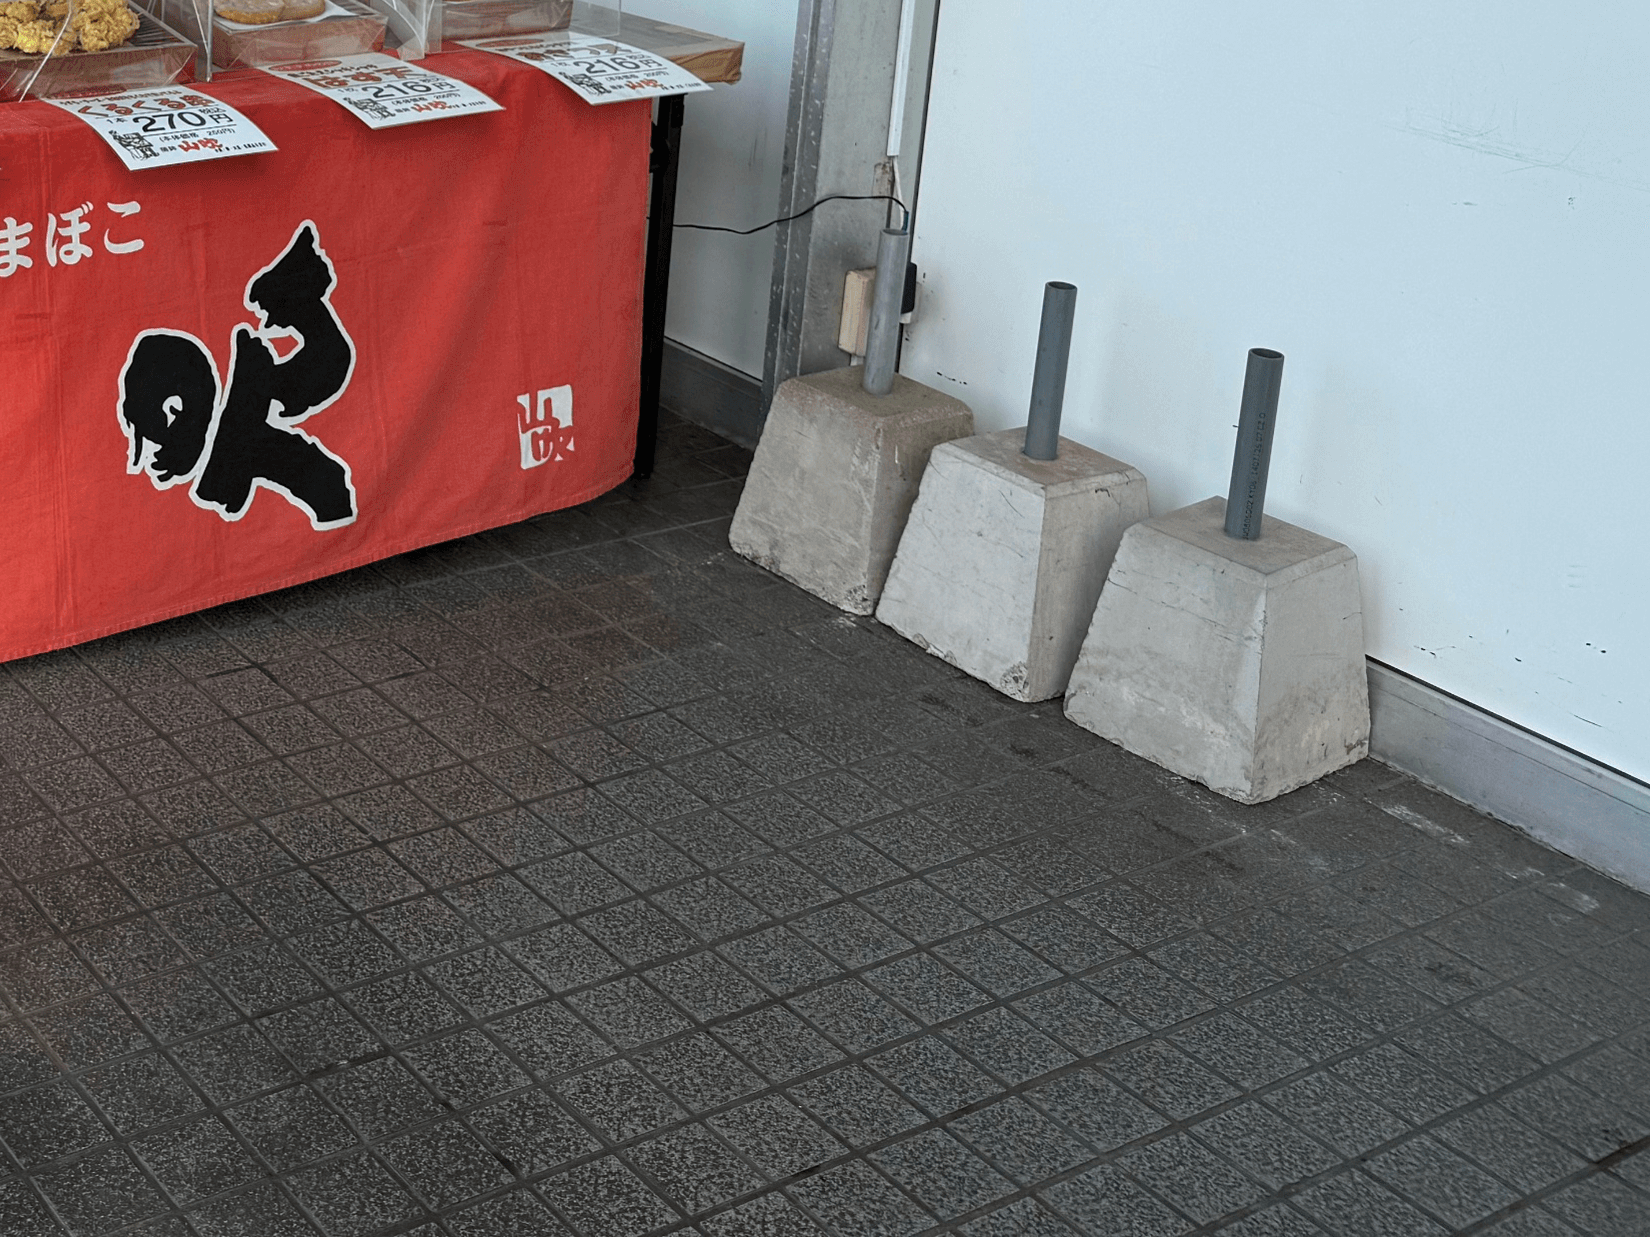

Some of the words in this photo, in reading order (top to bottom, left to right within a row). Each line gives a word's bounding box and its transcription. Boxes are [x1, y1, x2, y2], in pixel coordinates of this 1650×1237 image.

[573, 56, 642, 76] 216
[361, 80, 433, 100] 216
[132, 111, 207, 133] 270
[207, 113, 234, 125] 円
